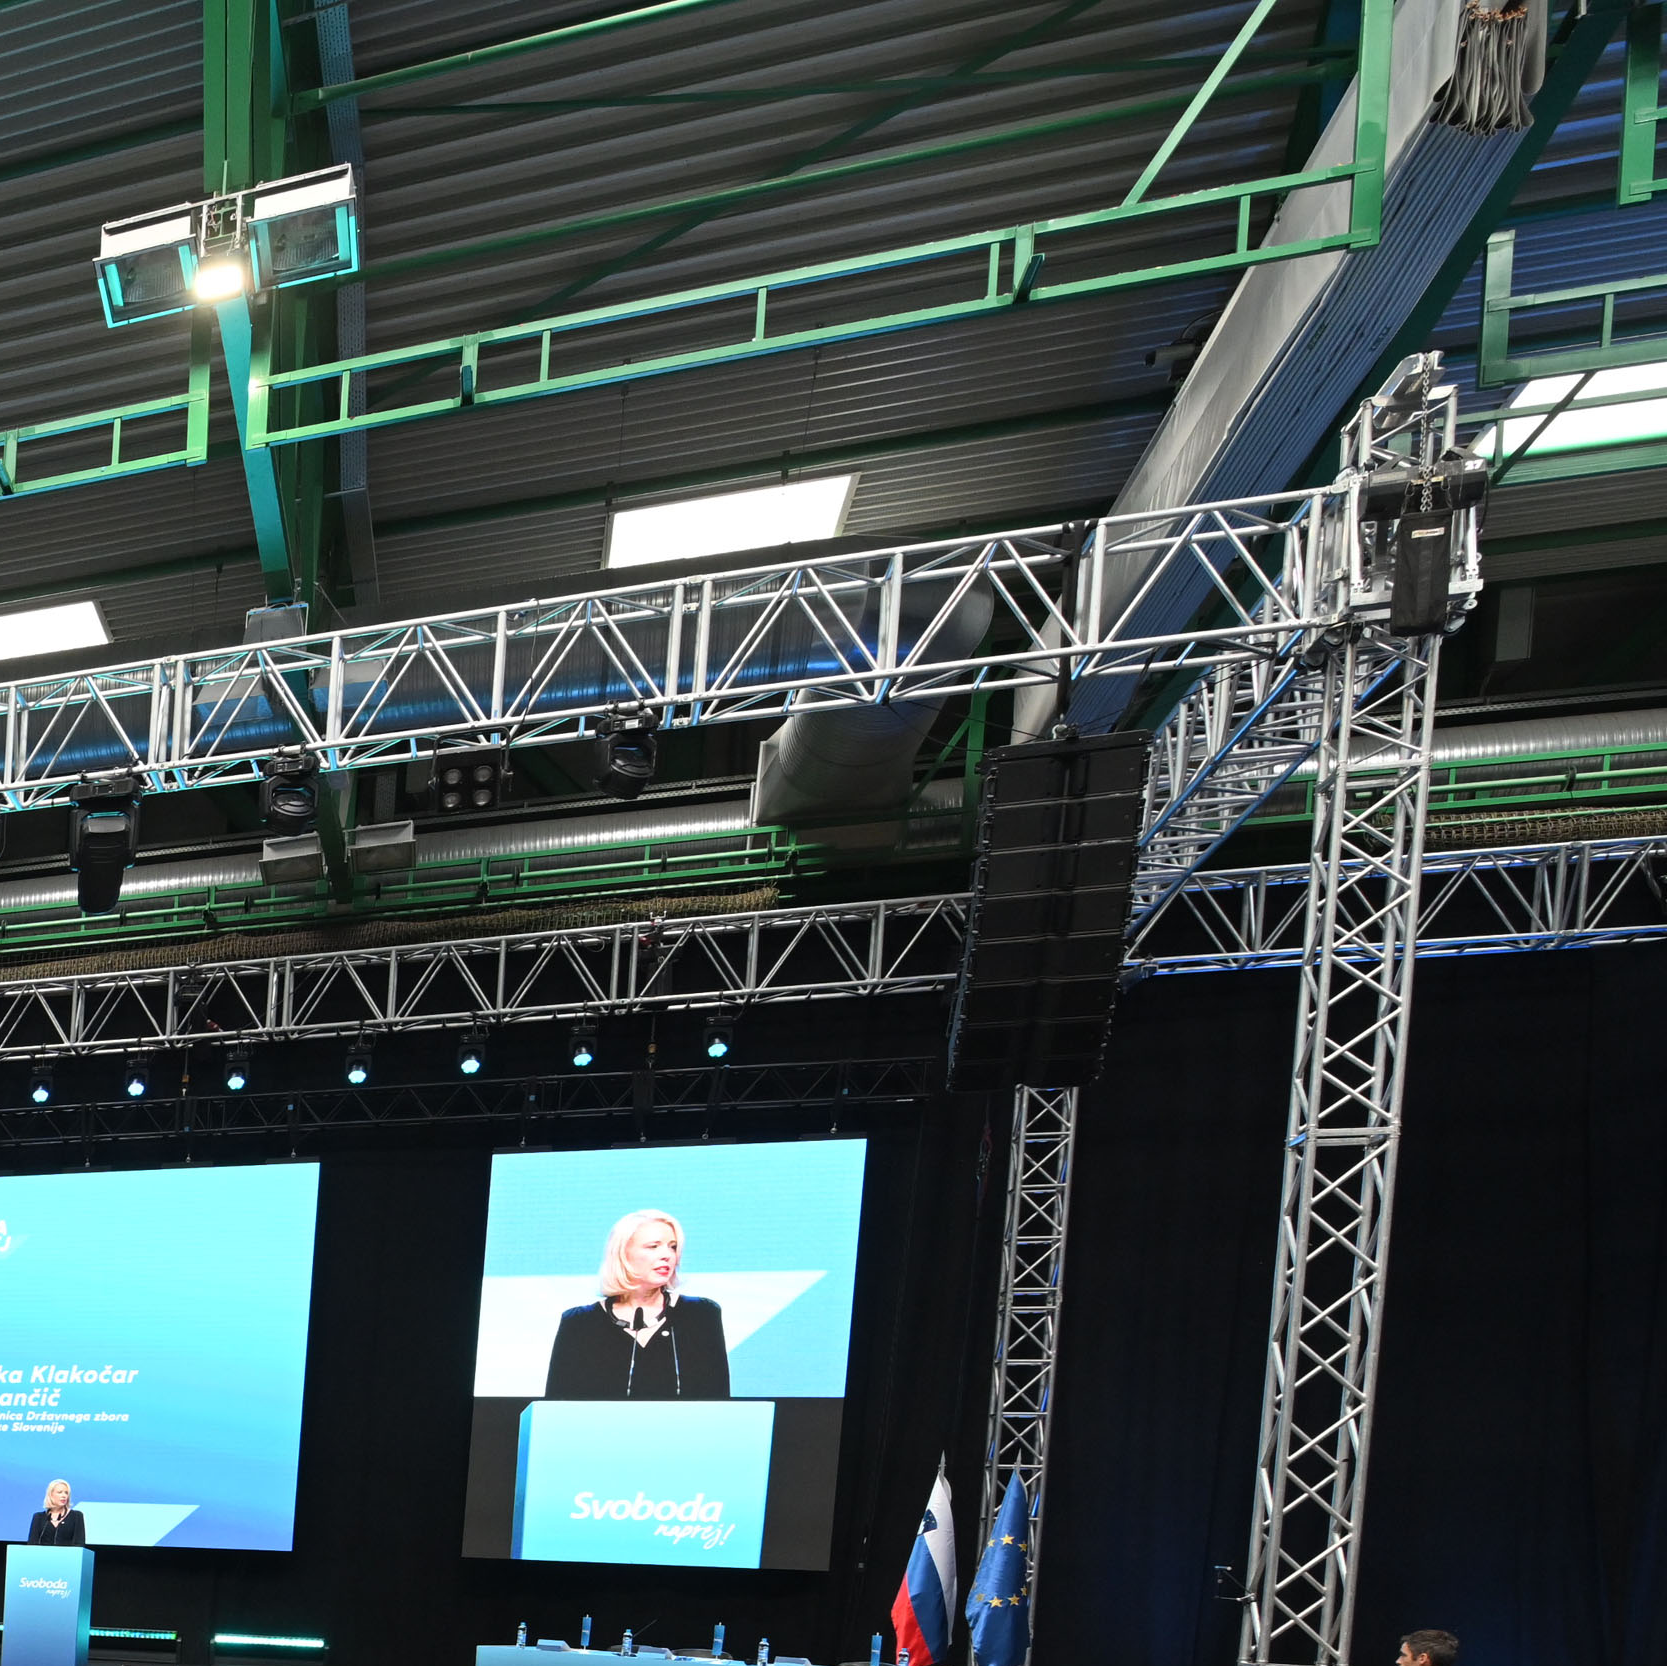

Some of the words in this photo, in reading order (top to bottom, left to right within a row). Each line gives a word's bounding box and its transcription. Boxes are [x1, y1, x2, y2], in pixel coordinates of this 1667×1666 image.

[30, 1364, 139, 1384] Klakočar
[26, 1410, 92, 1423] Državnega
[93, 1411, 130, 1422] zbora
[11, 1421, 66, 1434] Slovenije
[569, 1491, 724, 1522] Svoboda
[653, 1523, 736, 1550] naprej!
[18, 1577, 68, 1589] Svoboda
